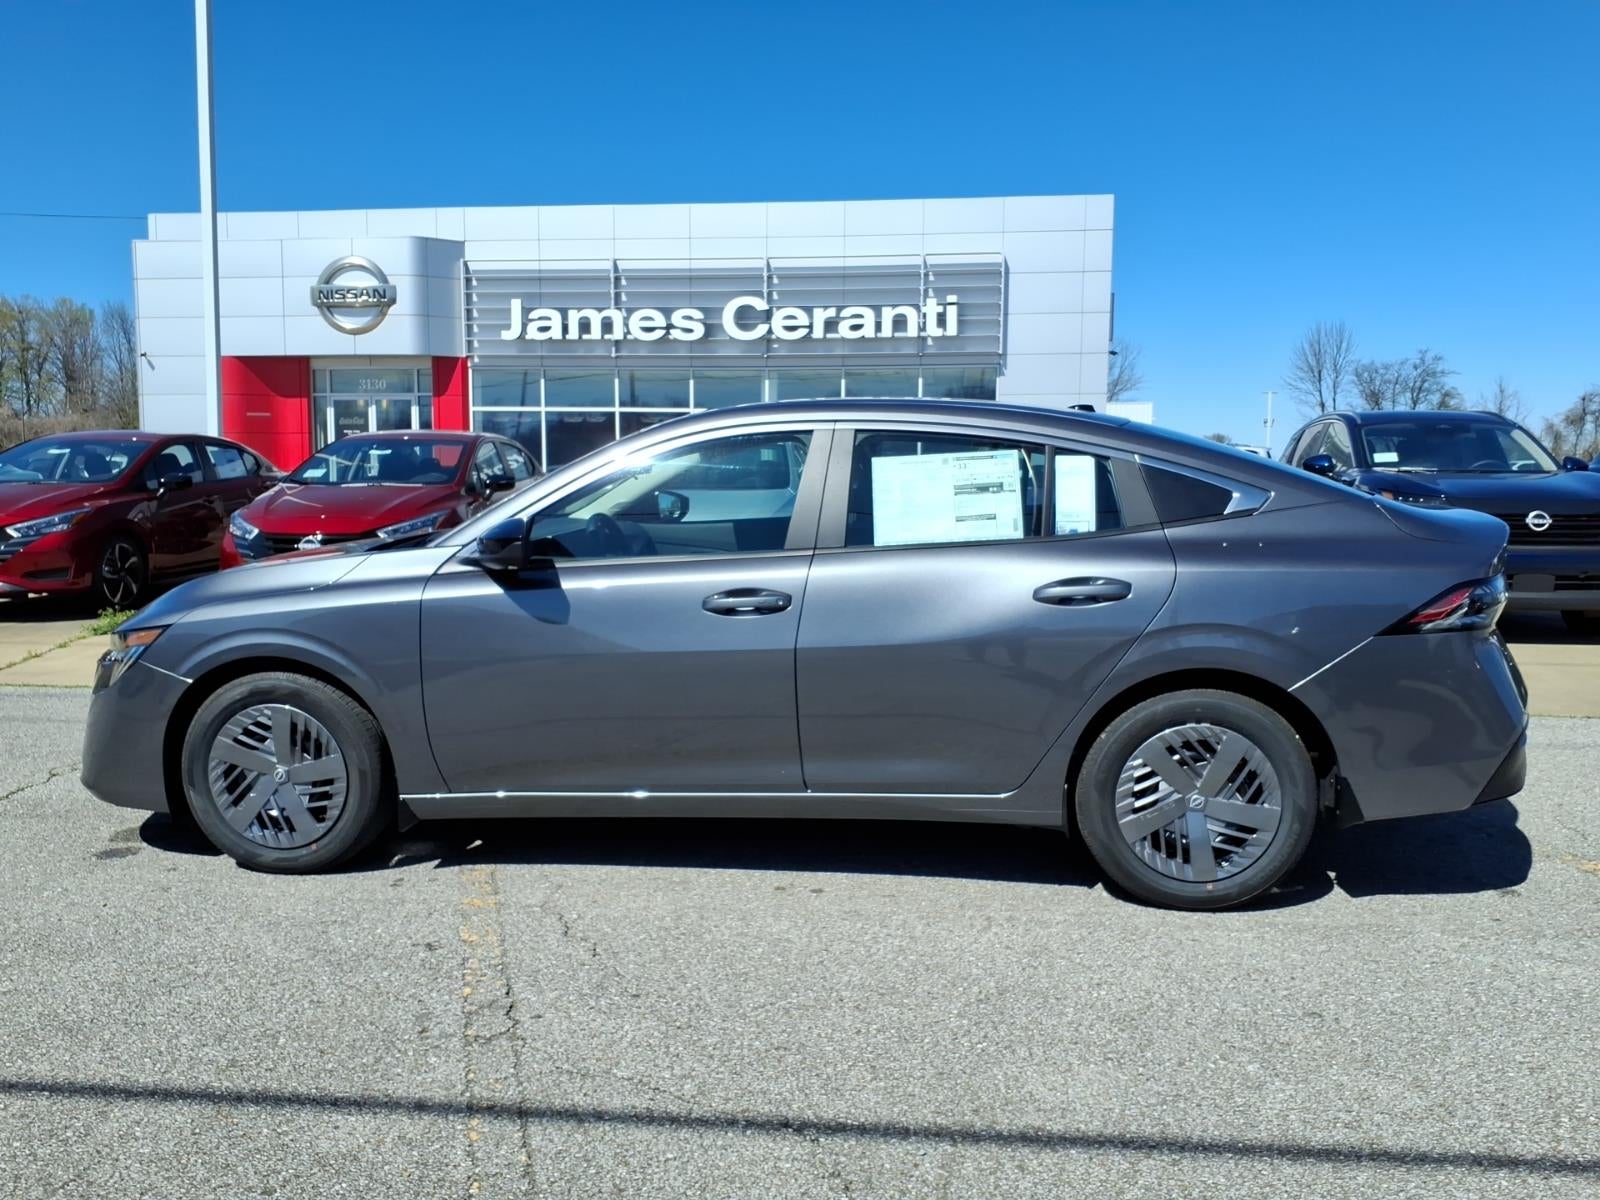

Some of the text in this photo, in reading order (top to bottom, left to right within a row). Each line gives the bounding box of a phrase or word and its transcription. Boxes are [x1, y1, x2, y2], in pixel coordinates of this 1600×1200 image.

[318, 288, 387, 301] NISSAN
[500, 295, 958, 341] James Ceranti
[359, 378, 386, 390] 3130
